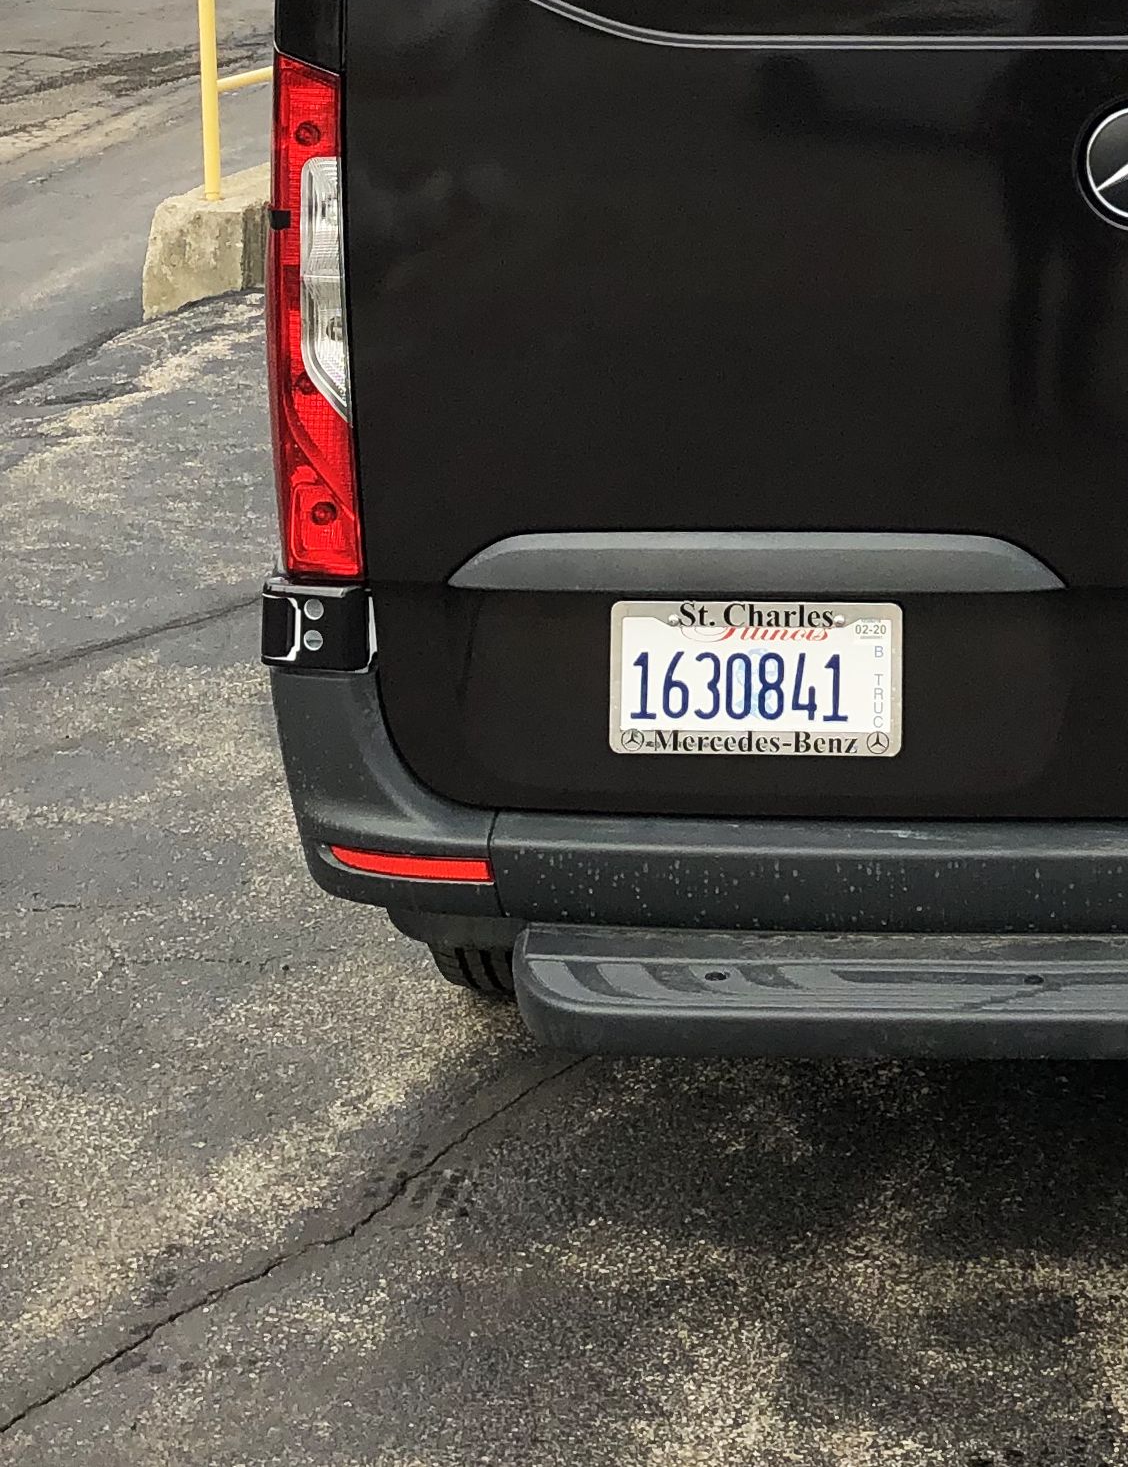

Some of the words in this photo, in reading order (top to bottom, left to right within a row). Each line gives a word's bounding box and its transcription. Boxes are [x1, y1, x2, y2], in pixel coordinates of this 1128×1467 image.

[679, 601, 716, 627] St.
[723, 602, 834, 627] Charles
[855, 624, 887, 635] 02-20
[874, 645, 884, 658] B
[630, 650, 849, 722] 1630841
[873, 673, 884, 729] TRUC
[654, 730, 858, 754] Mercedes-Benz
